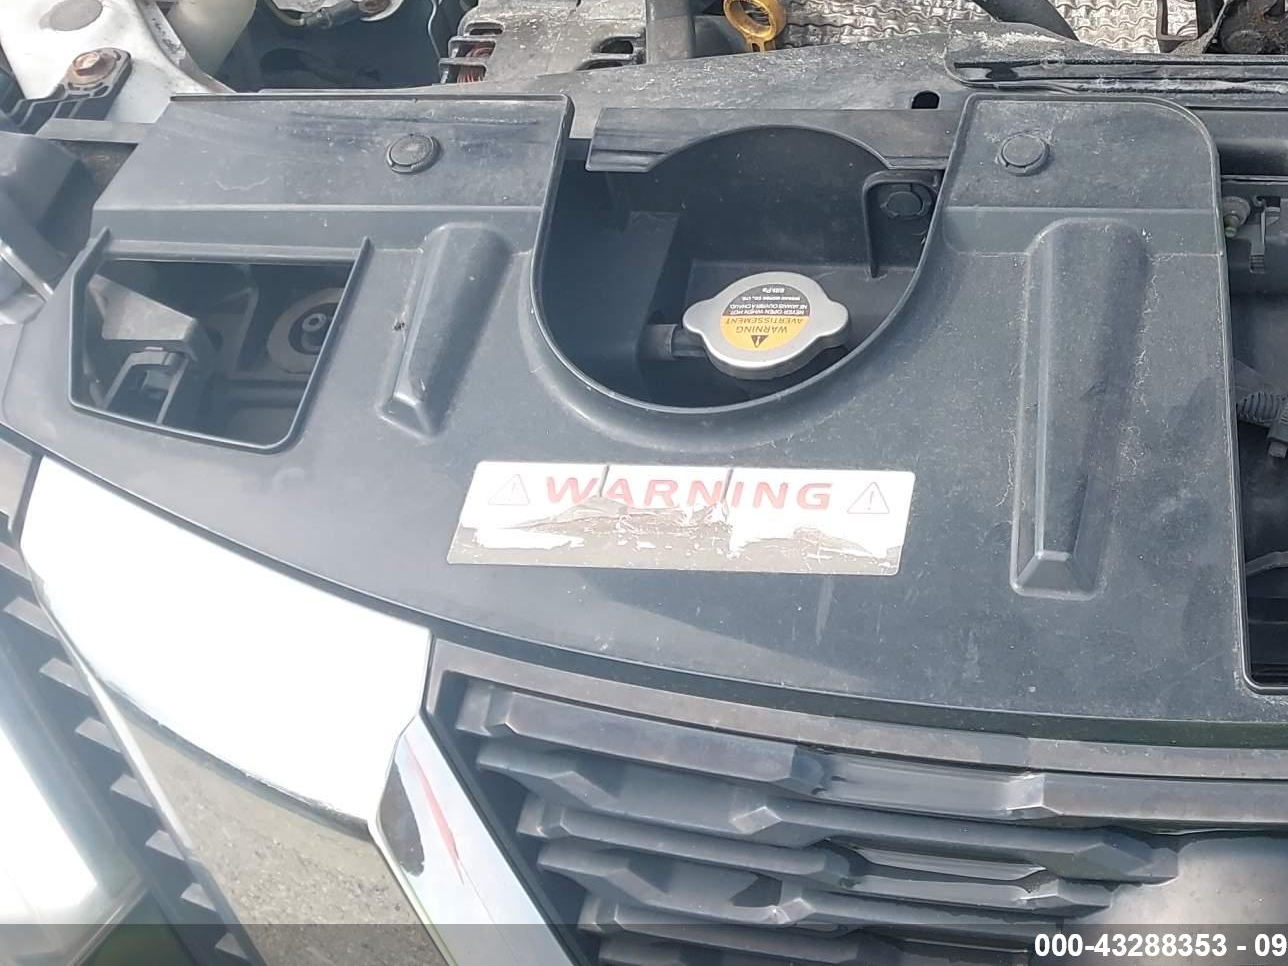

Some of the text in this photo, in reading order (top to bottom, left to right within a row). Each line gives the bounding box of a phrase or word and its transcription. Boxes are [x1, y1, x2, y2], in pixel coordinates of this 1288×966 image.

[725, 317, 803, 325] AVERTISSEMENT
[735, 325, 788, 334] WARNING
[547, 476, 834, 511] WARNING
